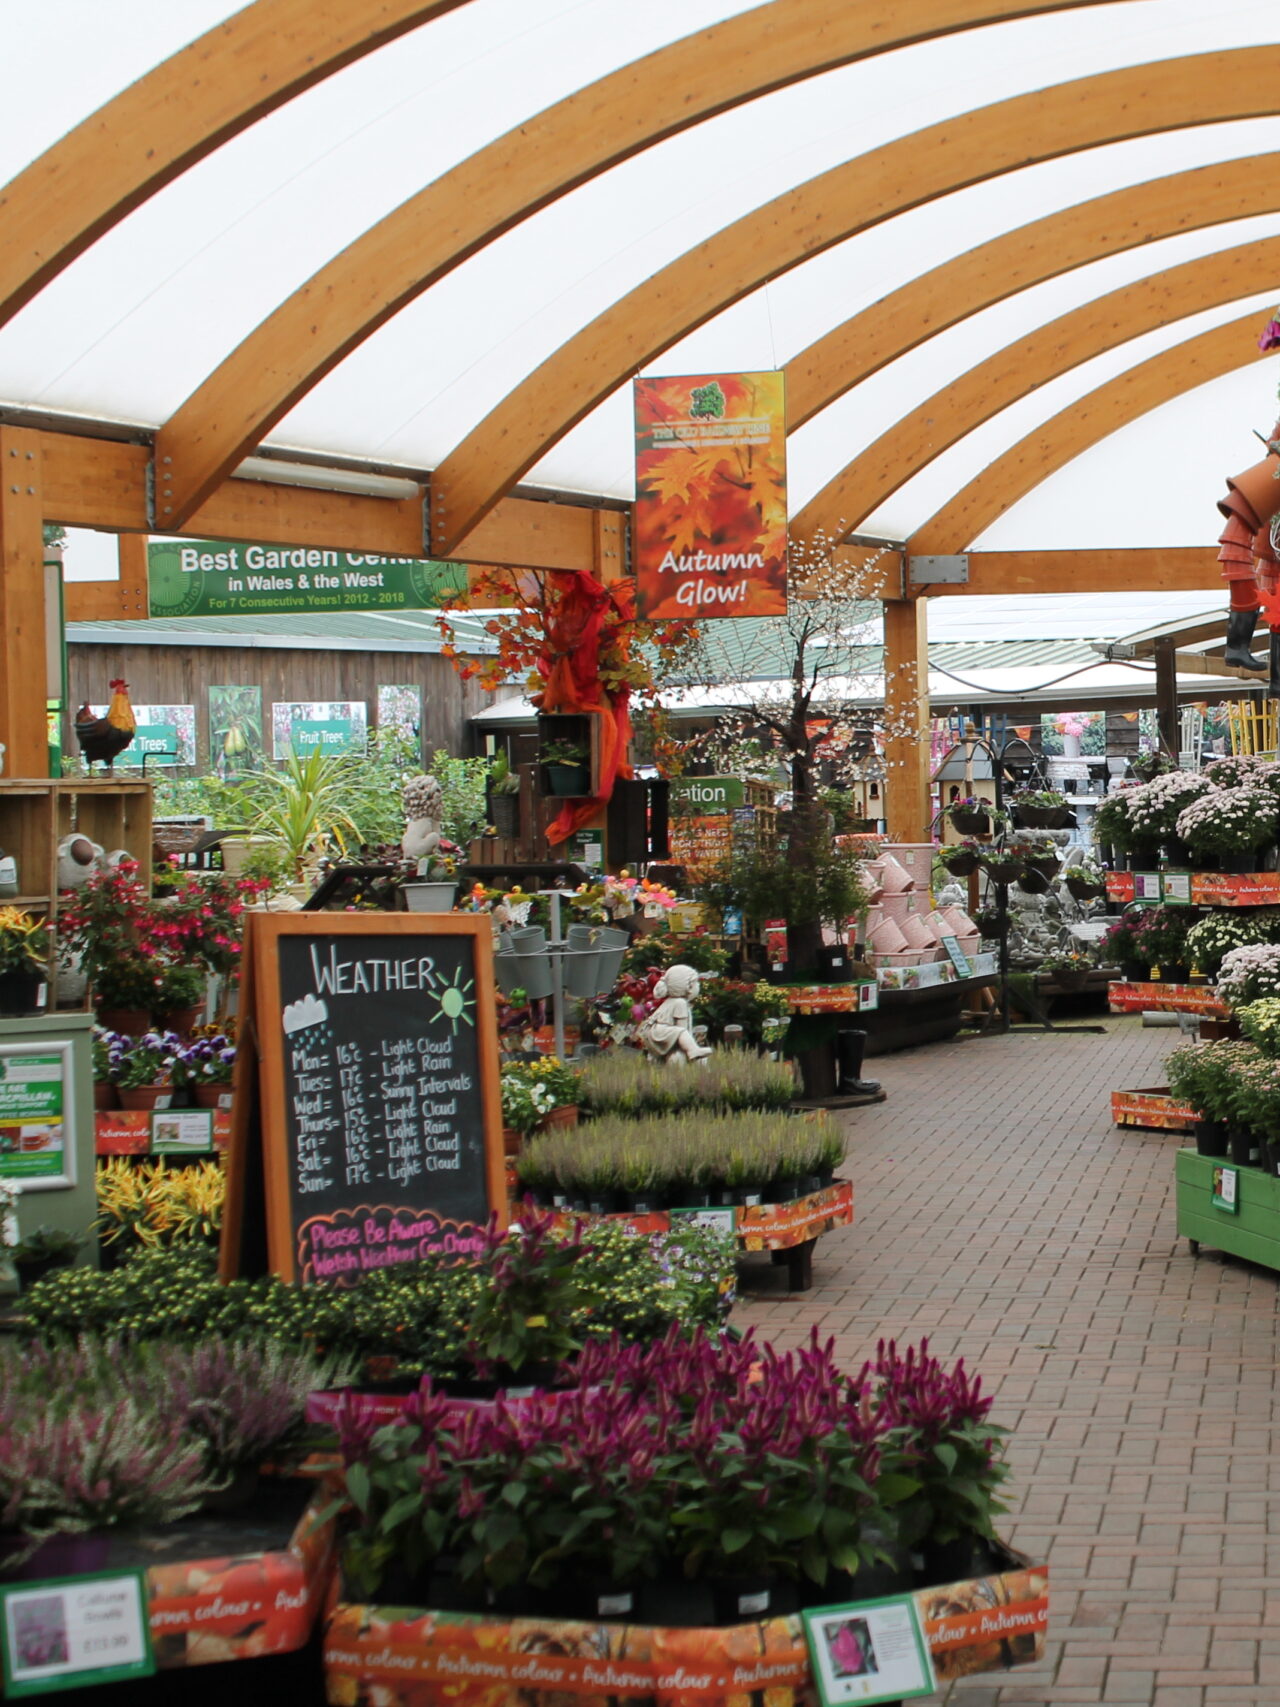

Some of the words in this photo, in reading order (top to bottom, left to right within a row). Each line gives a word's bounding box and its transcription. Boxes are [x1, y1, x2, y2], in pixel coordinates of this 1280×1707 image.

[181, 547, 239, 573] Best
[246, 545, 338, 571] Garden
[658, 549, 765, 574] Autumn
[228, 576, 243, 592] in
[246, 574, 294, 591] Wales
[297, 574, 310, 589] &
[313, 573, 340, 589] the
[344, 571, 384, 588] West
[676, 579, 748, 606] Glow!
[209, 597, 228, 609] For
[230, 597, 237, 608] 7
[239, 596, 306, 608] Consecutive
[310, 594, 341, 606] Years!
[344, 593, 369, 605] 2012
[379, 592, 405, 604] 2018
[138, 736, 168, 751] Trees
[300, 731, 320, 744] Fruit
[321, 730, 344, 743] Trees
[310, 943, 437, 996] WEATHER
[381, 1037, 416, 1062] Light
[417, 1035, 452, 1054] Cloud
[382, 1059, 417, 1086] Light
[422, 1055, 452, 1072] Rain
[380, 1081, 416, 1108] Sunny
[417, 1073, 472, 1096] Intervals
[385, 1103, 418, 1125] Light
[422, 1098, 457, 1116] Cloud
[385, 1122, 418, 1145] Light
[424, 1120, 450, 1136] Rain
[388, 1139, 421, 1165] Light
[425, 1132, 460, 1152] Cloud
[388, 1162, 421, 1187] Light
[426, 1152, 461, 1171] Cloud
[310, 1223, 361, 1250] Please
[364, 1218, 386, 1245] Be
[388, 1218, 438, 1242] Aware
[312, 1251, 359, 1277] Welsh
[360, 1246, 417, 1270] Weather
[444, 1233, 485, 1261] Chang
[195, 1598, 252, 1622] colour
[926, 1624, 967, 1645] colour
[980, 1611, 1036, 1636] Autumn
[366, 1648, 417, 1669] colour
[436, 1653, 507, 1679] Autumn
[511, 1660, 565, 1682] colour
[582, 1665, 652, 1689] Autumn
[657, 1667, 711, 1690] colour
[733, 1660, 800, 1685] Autumn
